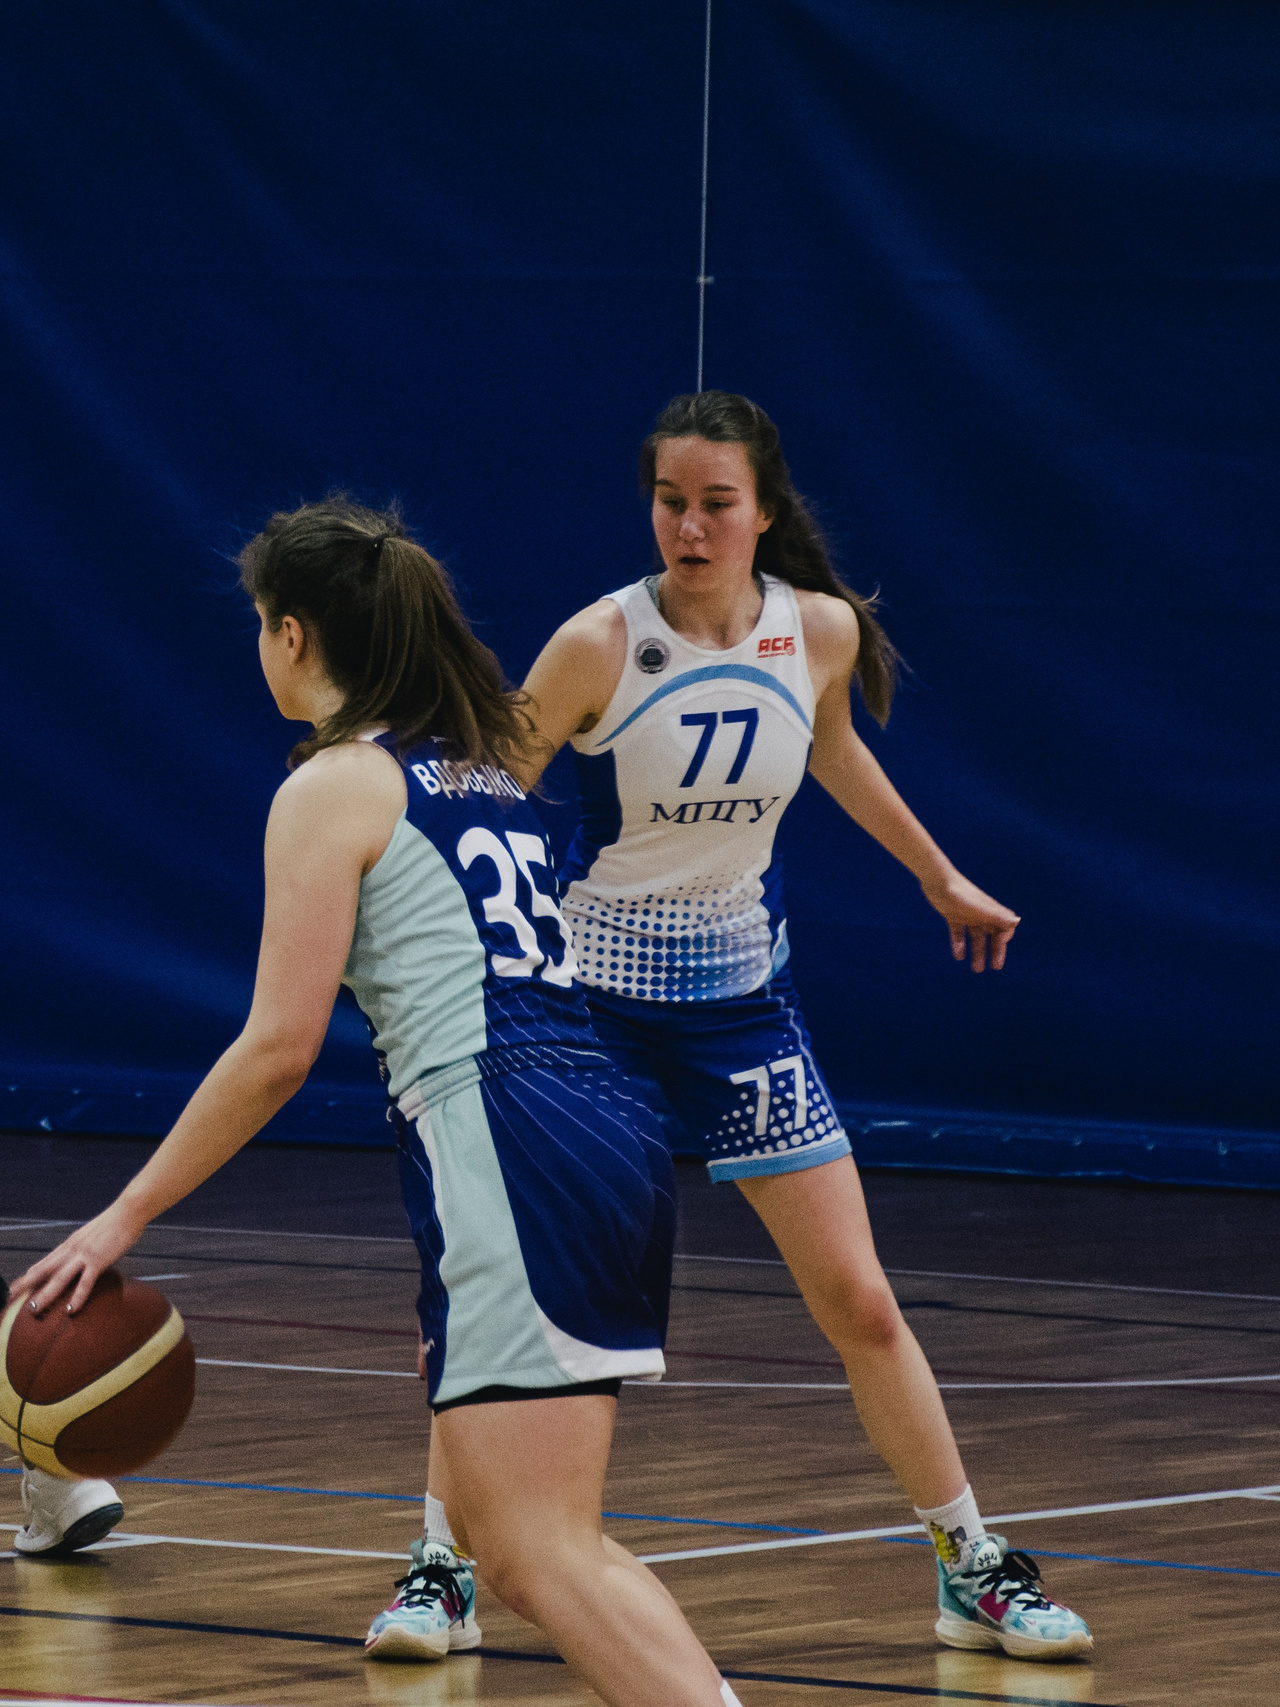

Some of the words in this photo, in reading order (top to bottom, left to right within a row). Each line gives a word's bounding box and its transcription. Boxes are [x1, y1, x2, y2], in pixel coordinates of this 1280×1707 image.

[679, 707, 759, 788] 77
[650, 796, 781, 824] МПГУ
[457, 827, 580, 988] 35
[729, 1054, 807, 1137] 77
